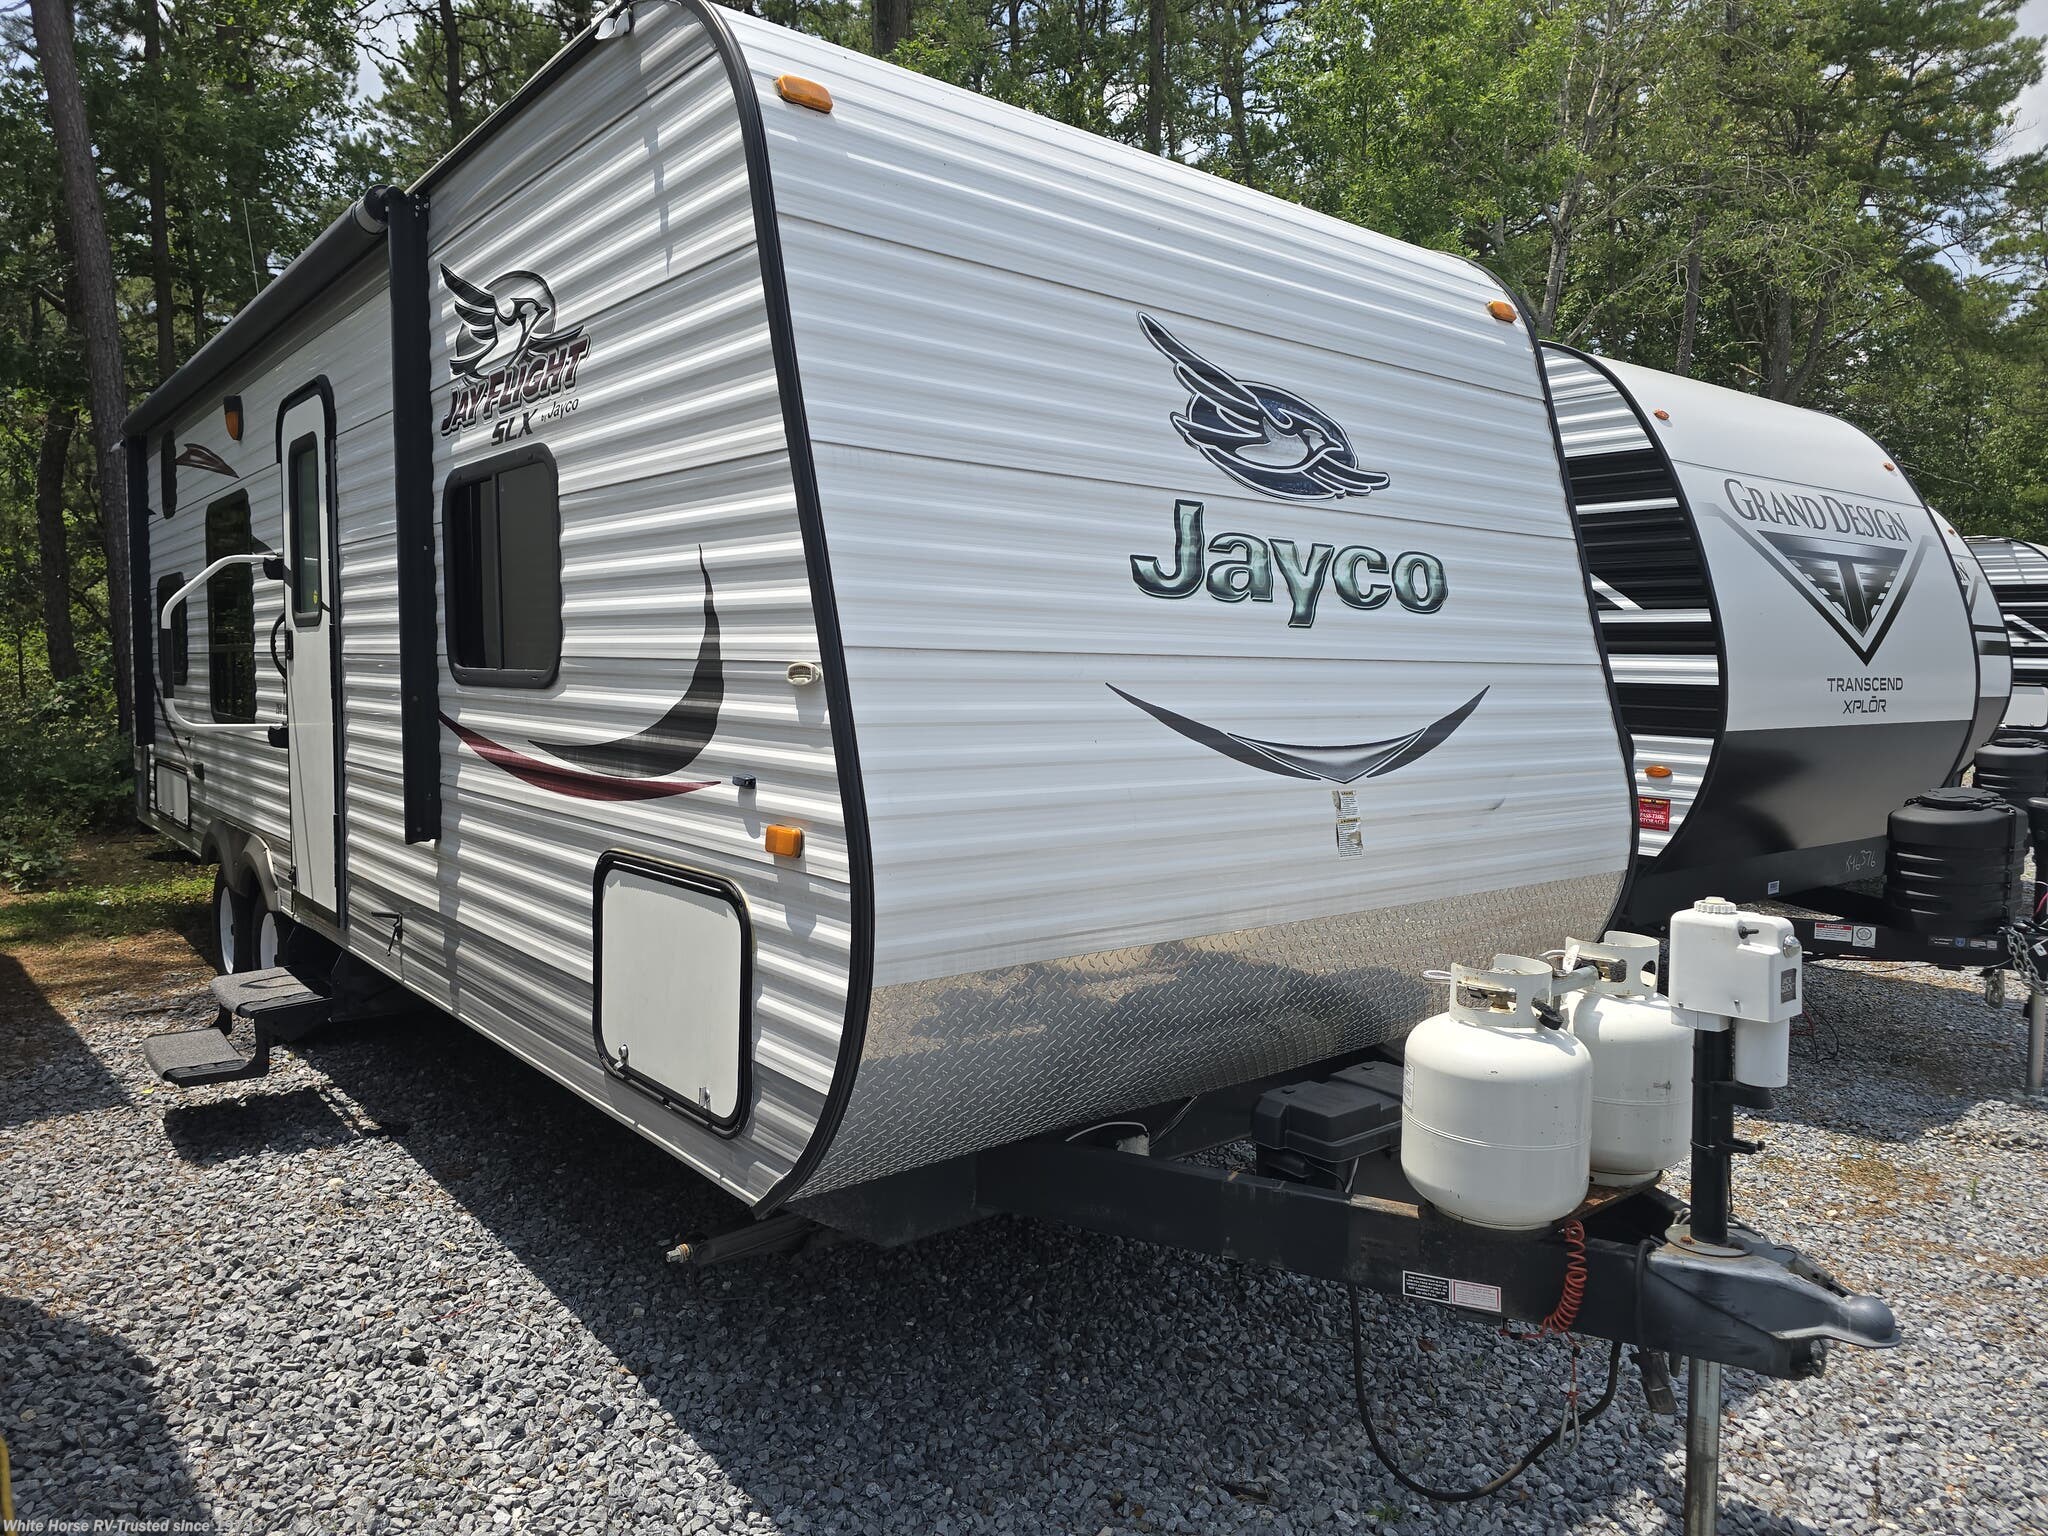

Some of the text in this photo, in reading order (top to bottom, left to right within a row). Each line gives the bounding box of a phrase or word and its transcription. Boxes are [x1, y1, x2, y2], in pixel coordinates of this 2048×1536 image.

[491, 408, 538, 446] SLX
[547, 398, 579, 419] Jayco
[1723, 478, 1913, 543] GRAND DESIGN
[1130, 499, 1448, 628] Jayco
[1827, 677, 1904, 692] TRANSCEND
